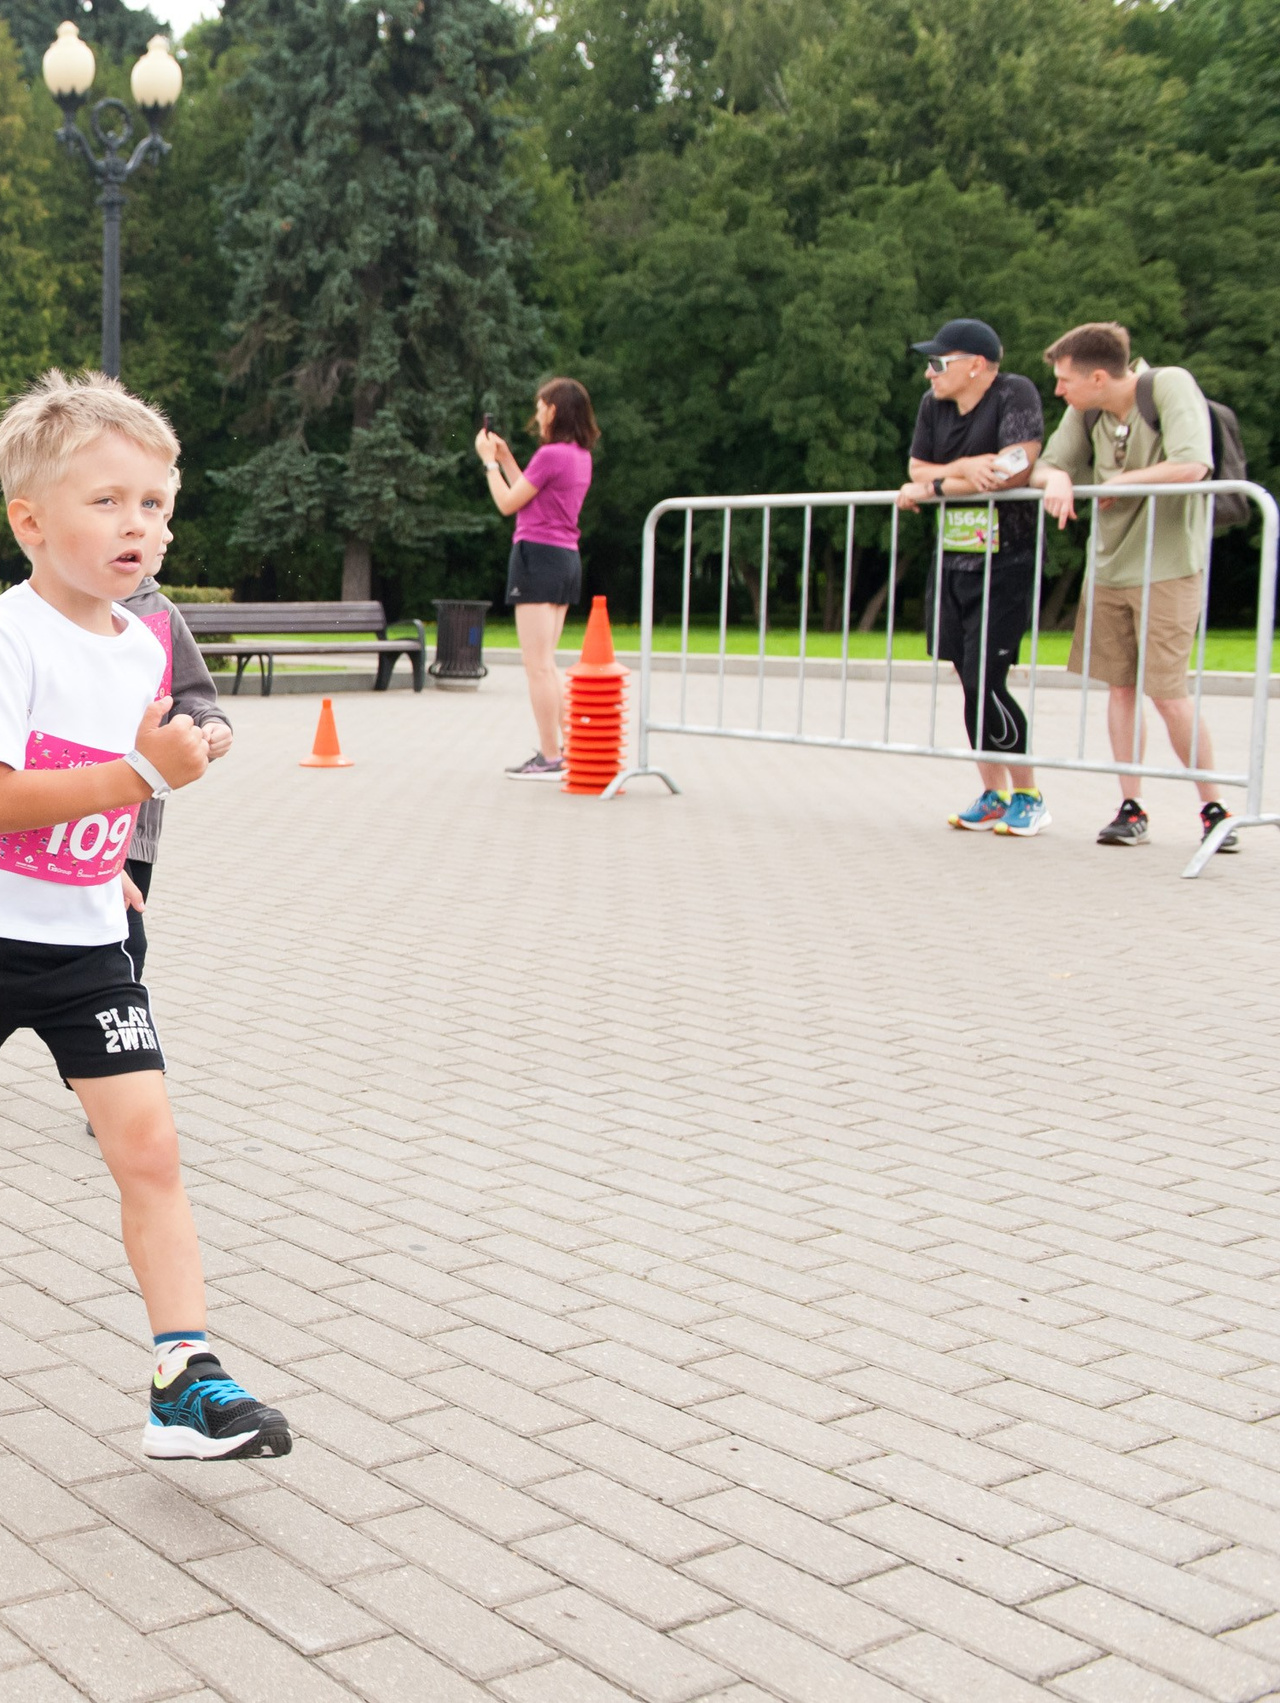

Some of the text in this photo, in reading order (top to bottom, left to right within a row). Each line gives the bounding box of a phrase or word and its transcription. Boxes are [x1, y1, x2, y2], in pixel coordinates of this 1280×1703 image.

[946, 510, 989, 526] 1564
[46, 813, 132, 861] 109
[95, 1006, 150, 1030] PLAY
[105, 1027, 158, 1054] 2WIN
